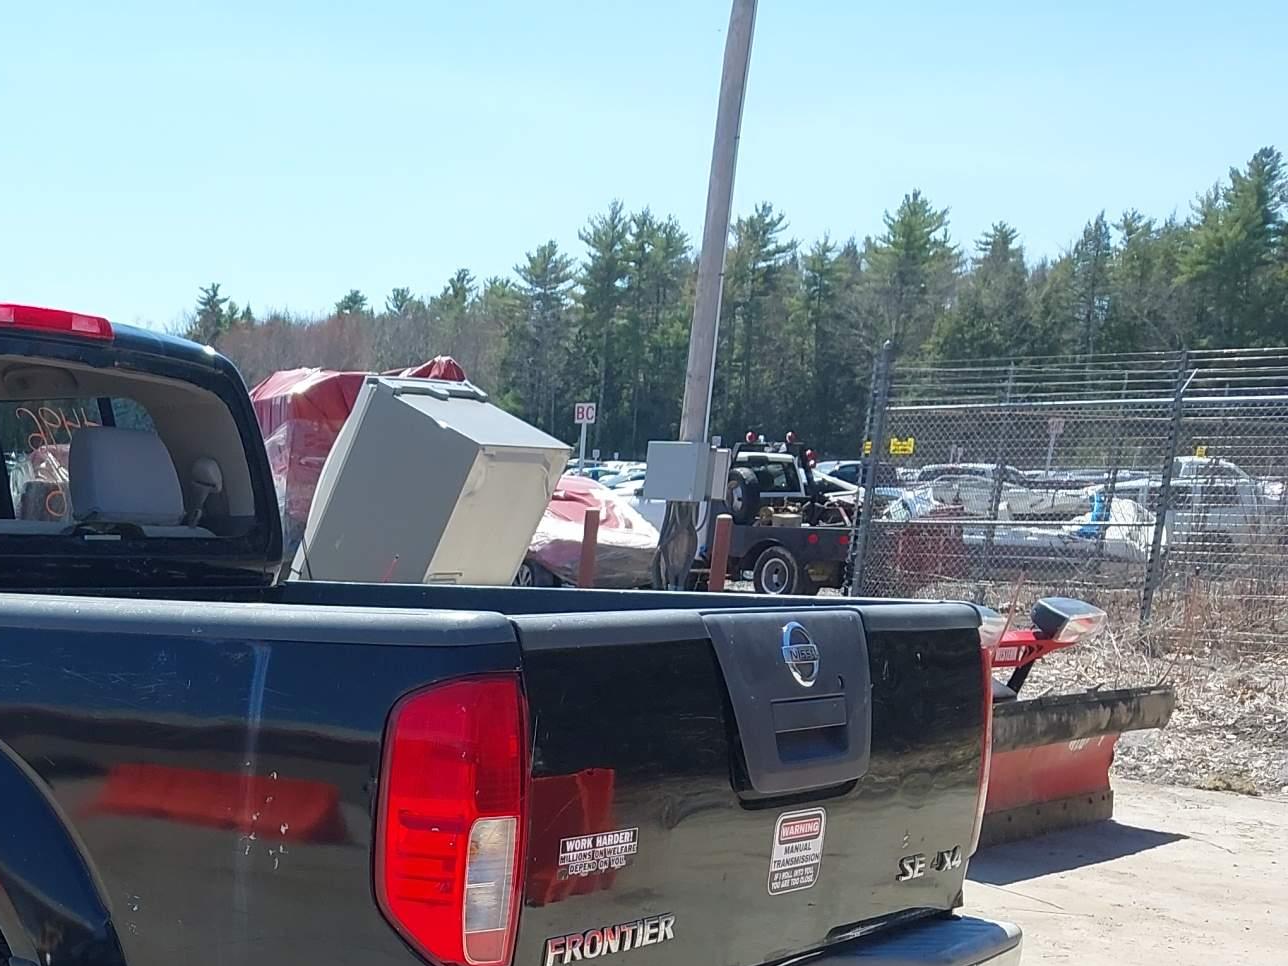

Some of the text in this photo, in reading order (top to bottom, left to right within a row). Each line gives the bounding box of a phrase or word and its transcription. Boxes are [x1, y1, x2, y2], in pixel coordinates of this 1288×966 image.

[577, 406, 595, 420] BC
[782, 822, 819, 837] WARNING
[566, 831, 633, 851] WORK HARDER!
[784, 842, 811, 855] MANUAL
[560, 845, 637, 863] MILLIONS ON WELFARE
[773, 853, 819, 868] TRANSMISSION
[569, 861, 597, 873] DEPEND
[599, 859, 608, 868] ON
[897, 853, 926, 881] SE
